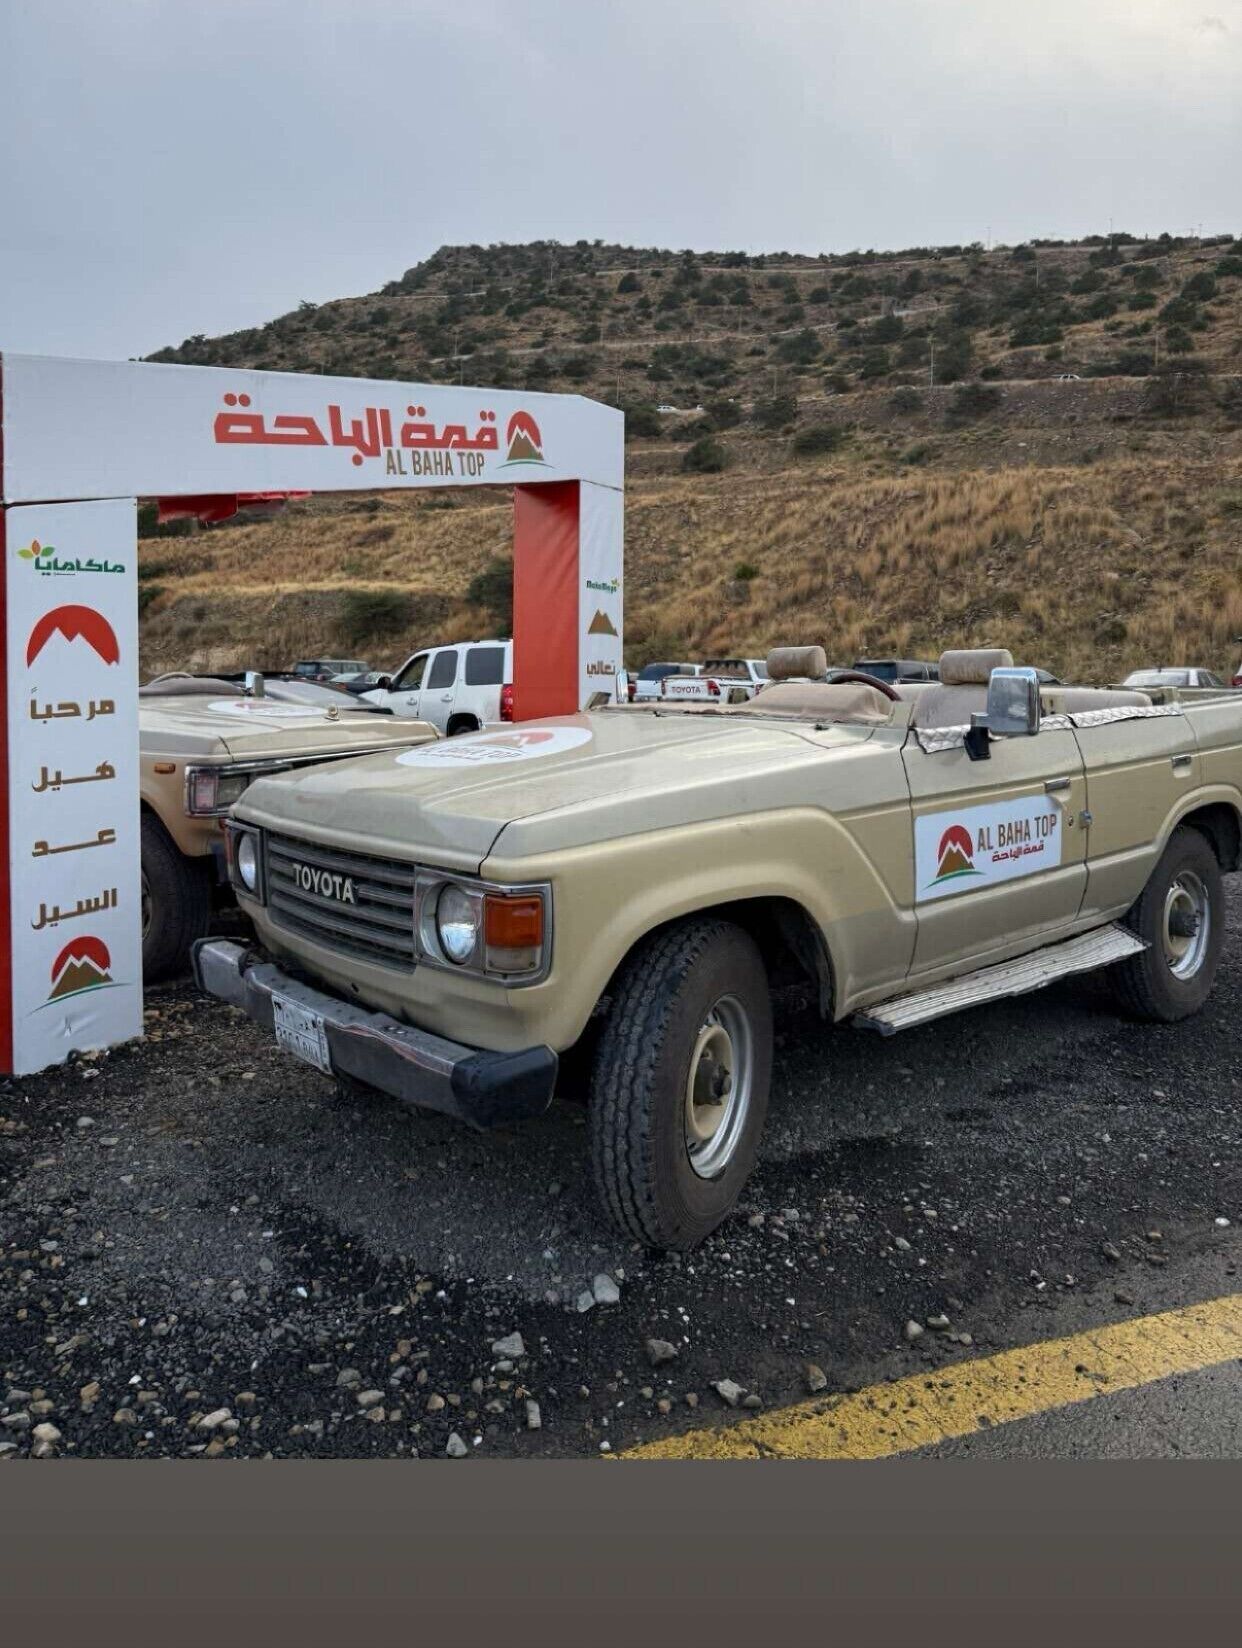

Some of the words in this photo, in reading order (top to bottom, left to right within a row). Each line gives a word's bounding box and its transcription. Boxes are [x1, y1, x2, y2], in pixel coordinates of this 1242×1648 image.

[213, 392, 393, 467] الباحة
[401, 405, 499, 450] قمة
[386, 449, 408, 475] AL
[412, 449, 454, 476] BAHA
[457, 451, 485, 477] TOP
[671, 686, 701, 694] TOYOTA
[977, 827, 994, 852] AL
[998, 819, 1031, 848] BAHA
[1034, 813, 1057, 839] TOP
[1023, 840, 1044, 854] قمة
[292, 863, 355, 904] TOYOTA
[31, 888, 118, 930] السيل
